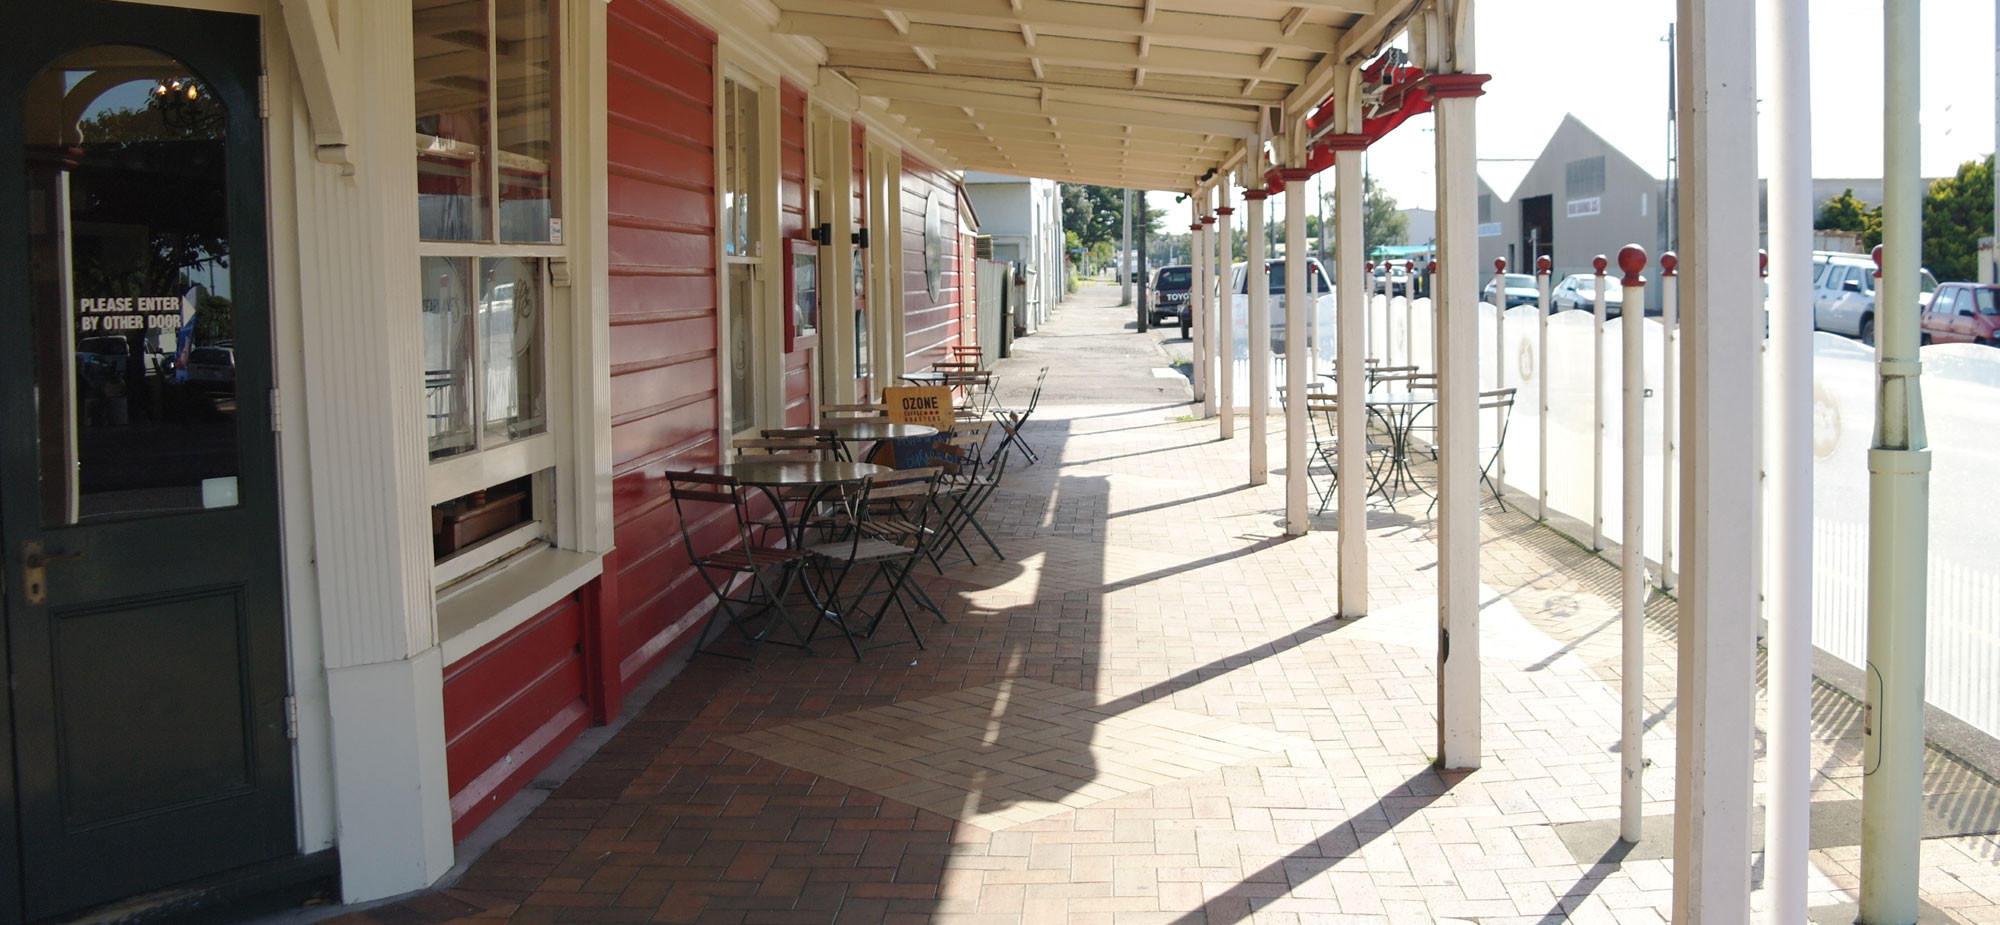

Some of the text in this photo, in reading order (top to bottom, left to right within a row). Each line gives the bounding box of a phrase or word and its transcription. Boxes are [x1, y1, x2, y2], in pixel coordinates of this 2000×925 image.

[81, 296, 180, 312] PLEASE ENTER
[1166, 292, 1192, 301] TOYO
[82, 314, 181, 331] BY OTHER DOOR
[902, 396, 939, 410] OZONE
